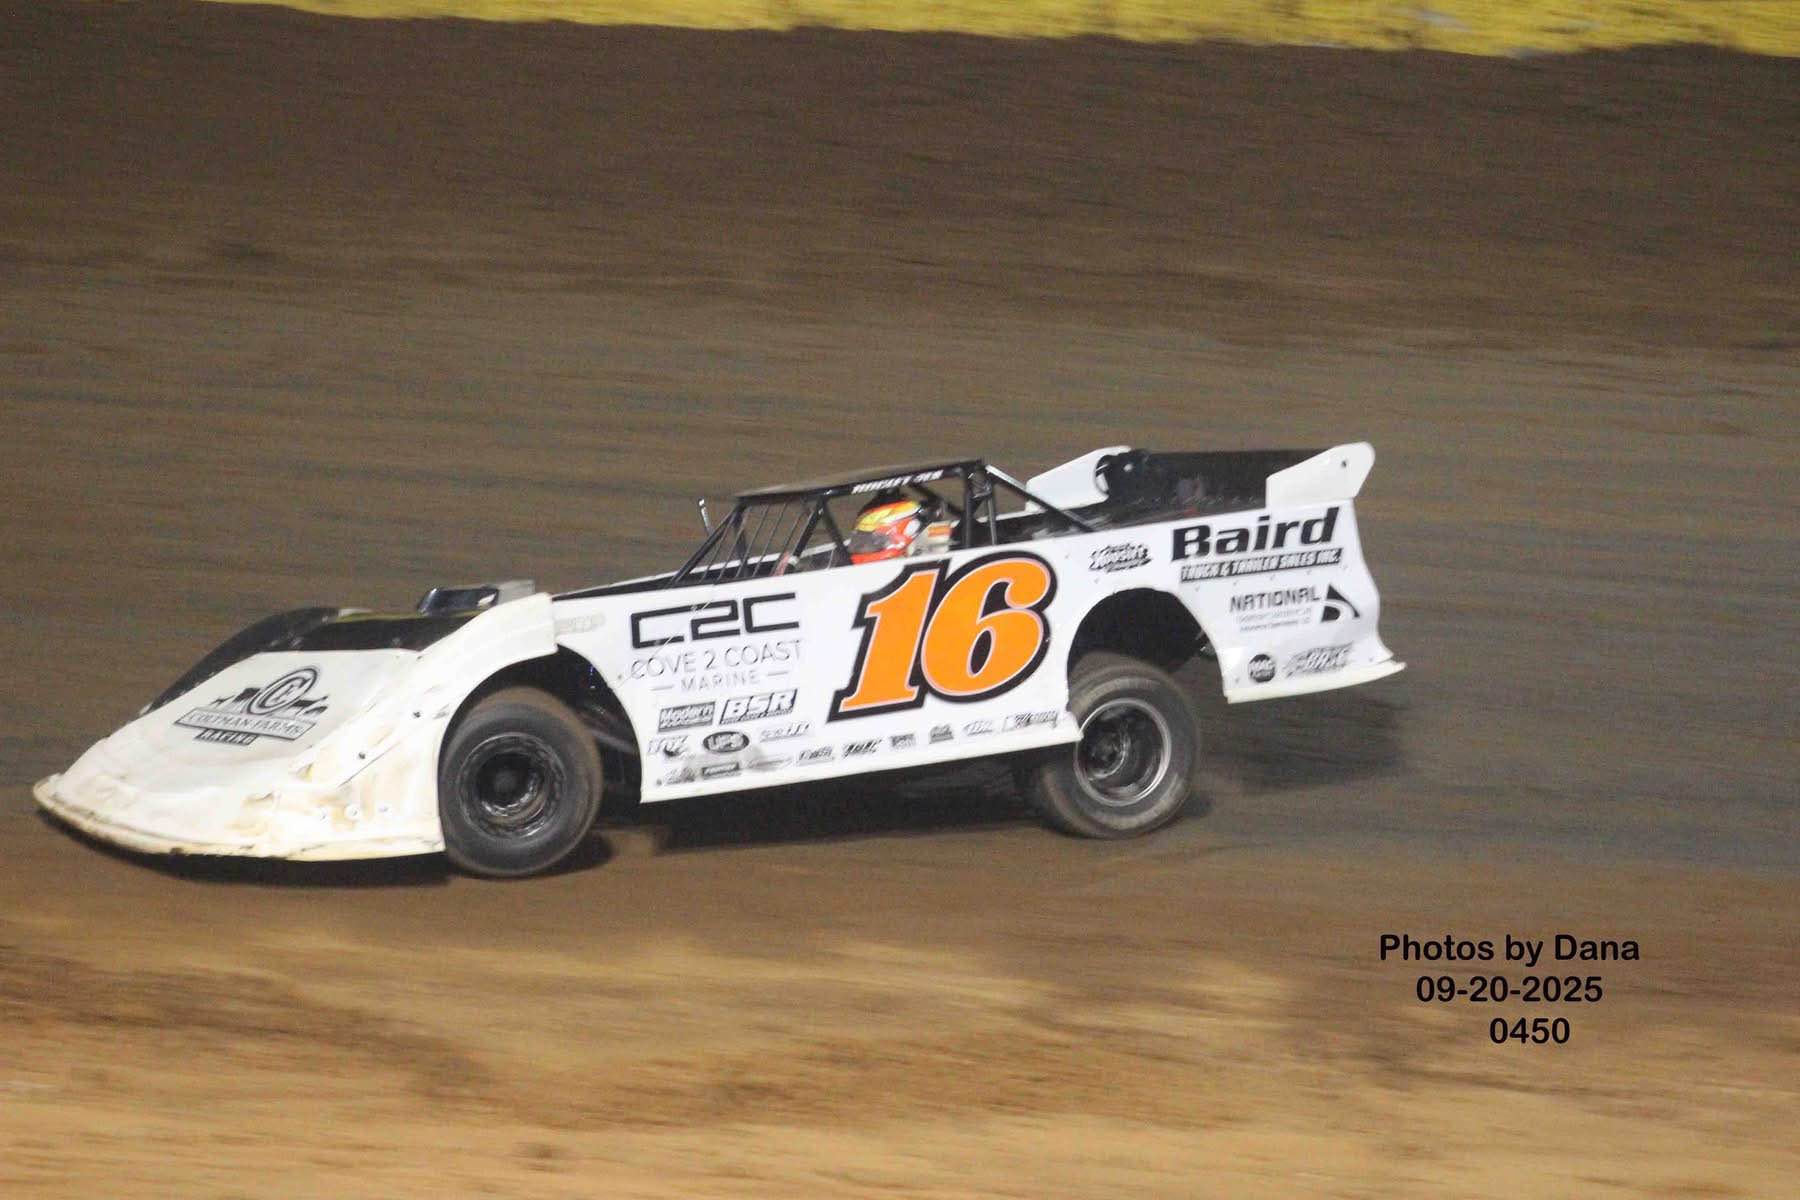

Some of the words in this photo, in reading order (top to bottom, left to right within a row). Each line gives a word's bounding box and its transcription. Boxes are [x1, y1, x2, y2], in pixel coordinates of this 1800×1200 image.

[1171, 507, 1340, 562] Baird
[1229, 585, 1321, 613] NATIONAL
[631, 592, 800, 649] C2C
[827, 555, 1058, 723] 16
[631, 653, 697, 679] COVE
[704, 650, 717, 669] 2
[724, 639, 802, 668] COAST
[681, 670, 761, 693] MARINE
[723, 690, 796, 719] BSR
